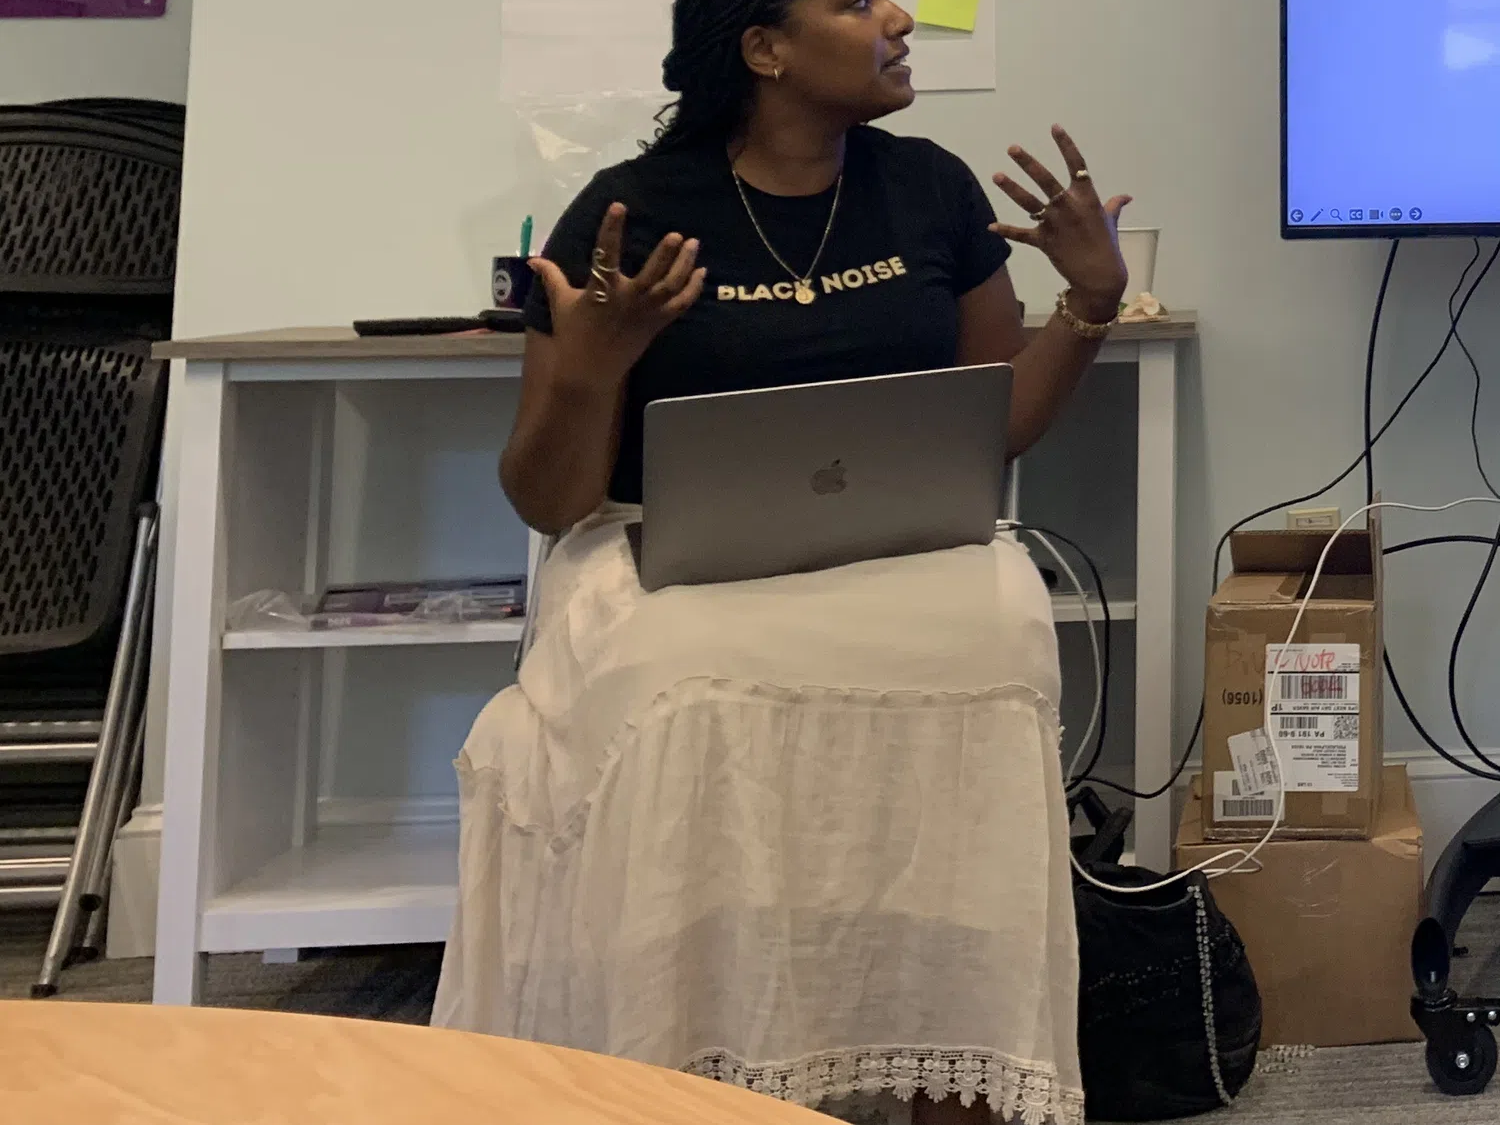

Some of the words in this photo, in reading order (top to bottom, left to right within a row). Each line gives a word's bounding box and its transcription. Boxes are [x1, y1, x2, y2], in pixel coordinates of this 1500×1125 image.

[820, 255, 907, 294] NOISE
[1222, 688, 1263, 705] (1056)
[1271, 703, 1283, 712] 1P
